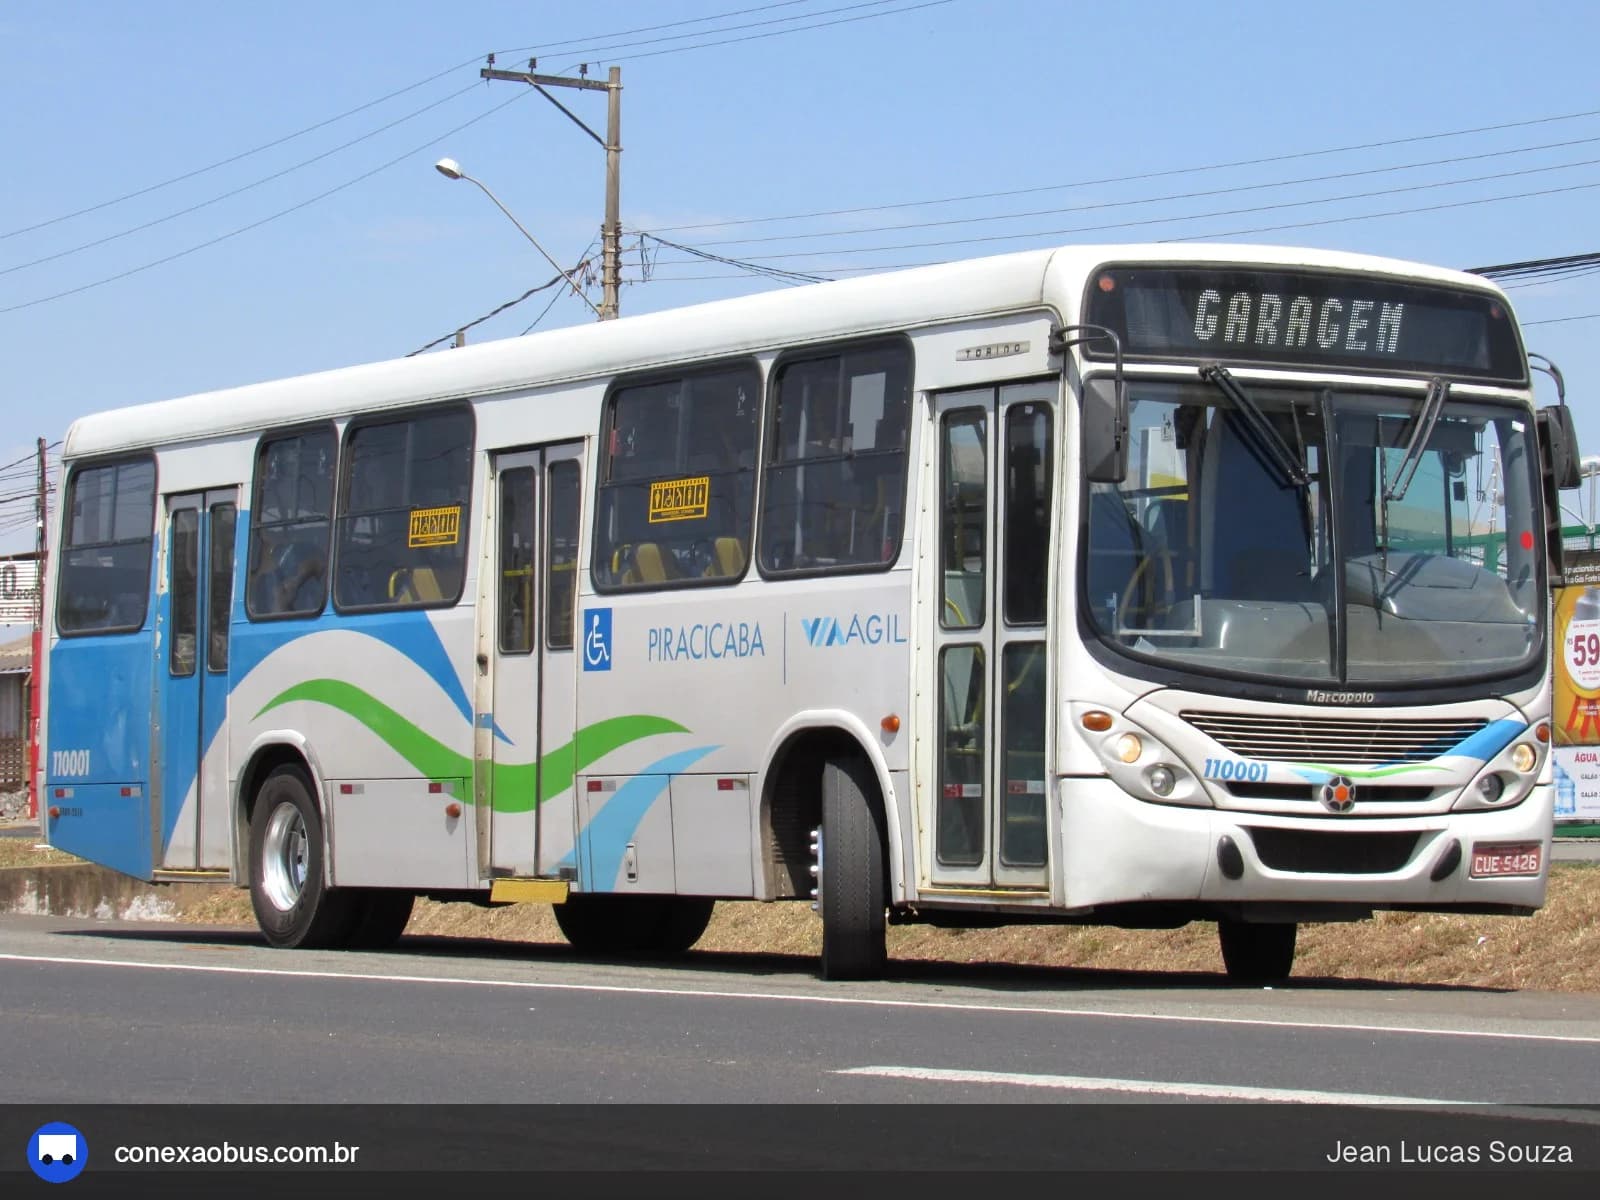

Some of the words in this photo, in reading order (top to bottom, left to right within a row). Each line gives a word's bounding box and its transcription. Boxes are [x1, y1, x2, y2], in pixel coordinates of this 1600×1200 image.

[1194, 289, 1404, 353] GARAGEM
[965, 343, 1021, 359] TORINO
[648, 621, 766, 662] PIRACICABA
[1306, 689, 1375, 704] Marcopolo
[52, 749, 90, 777] 110001
[1203, 758, 1268, 782] 110001
